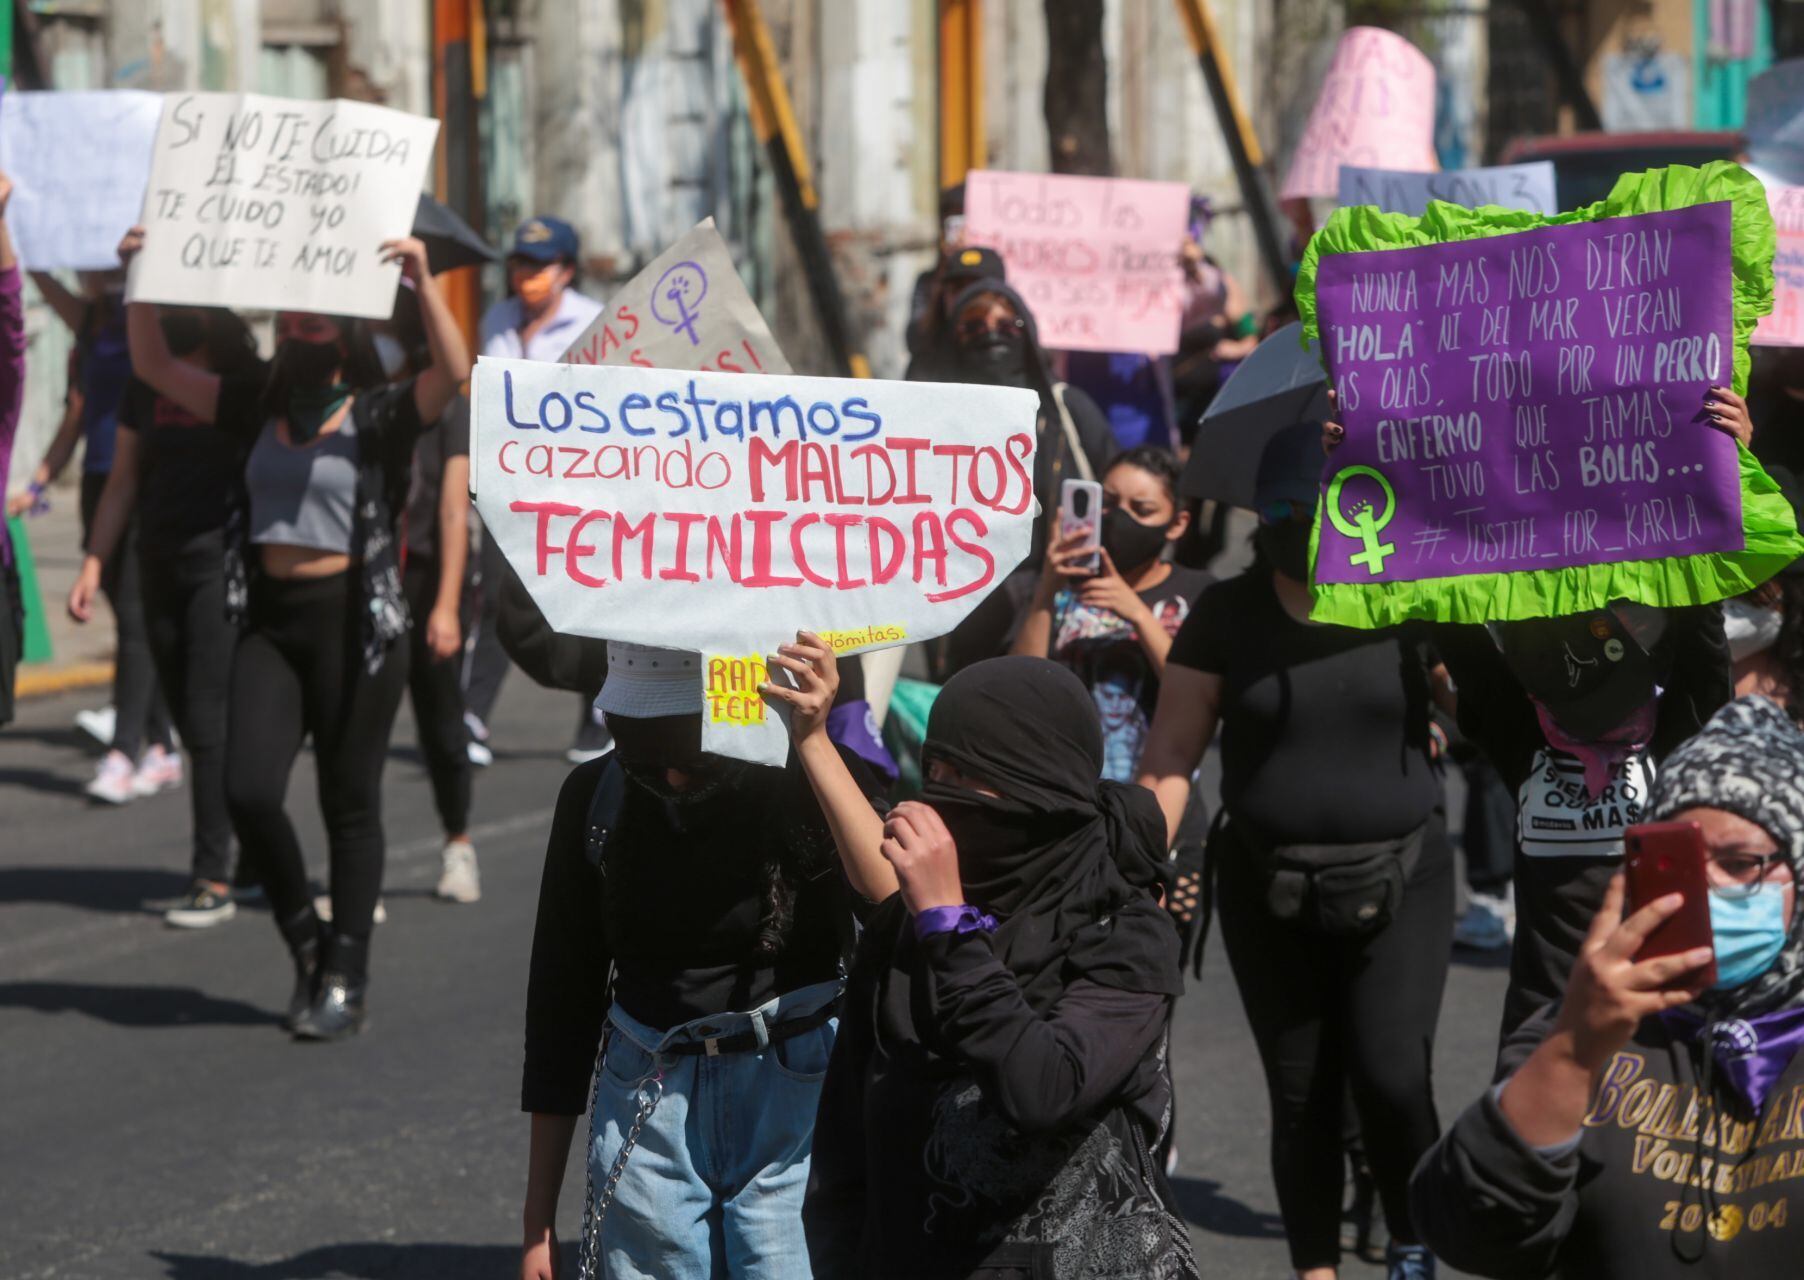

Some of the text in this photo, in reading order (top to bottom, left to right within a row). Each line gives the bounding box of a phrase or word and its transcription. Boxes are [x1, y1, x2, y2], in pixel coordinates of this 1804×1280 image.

[222, 111, 263, 152] NO
[268, 112, 310, 161] TE
[311, 113, 411, 166] CUIDA
[205, 154, 243, 188] EL
[156, 189, 186, 221] TE
[196, 193, 285, 229] CUIDO
[181, 232, 246, 270] QUE
[253, 238, 279, 269] TE
[1352, 228, 1673, 314] NUNCA MAS NOS DIRAN
[1438, 311, 1462, 353] NI
[1480, 305, 1511, 346] DEL
[1529, 297, 1579, 342] MAR
[1602, 286, 1682, 339] VERAN
[1380, 362, 1445, 410] OLAS,
[1468, 350, 1532, 403] TODO
[1558, 344, 1596, 396] POR
[1615, 344, 1645, 386] UN
[1654, 332, 1721, 384] PERRO
[1376, 388, 1673, 464] ENFERMO QUE JAMAS
[498, 433, 1033, 516] cazando MALDITOS
[1420, 460, 1486, 501] TUVO
[1514, 450, 1560, 495] LAS
[508, 501, 996, 603] FEMINICIDAS
[822, 624, 906, 649] dómitas.
